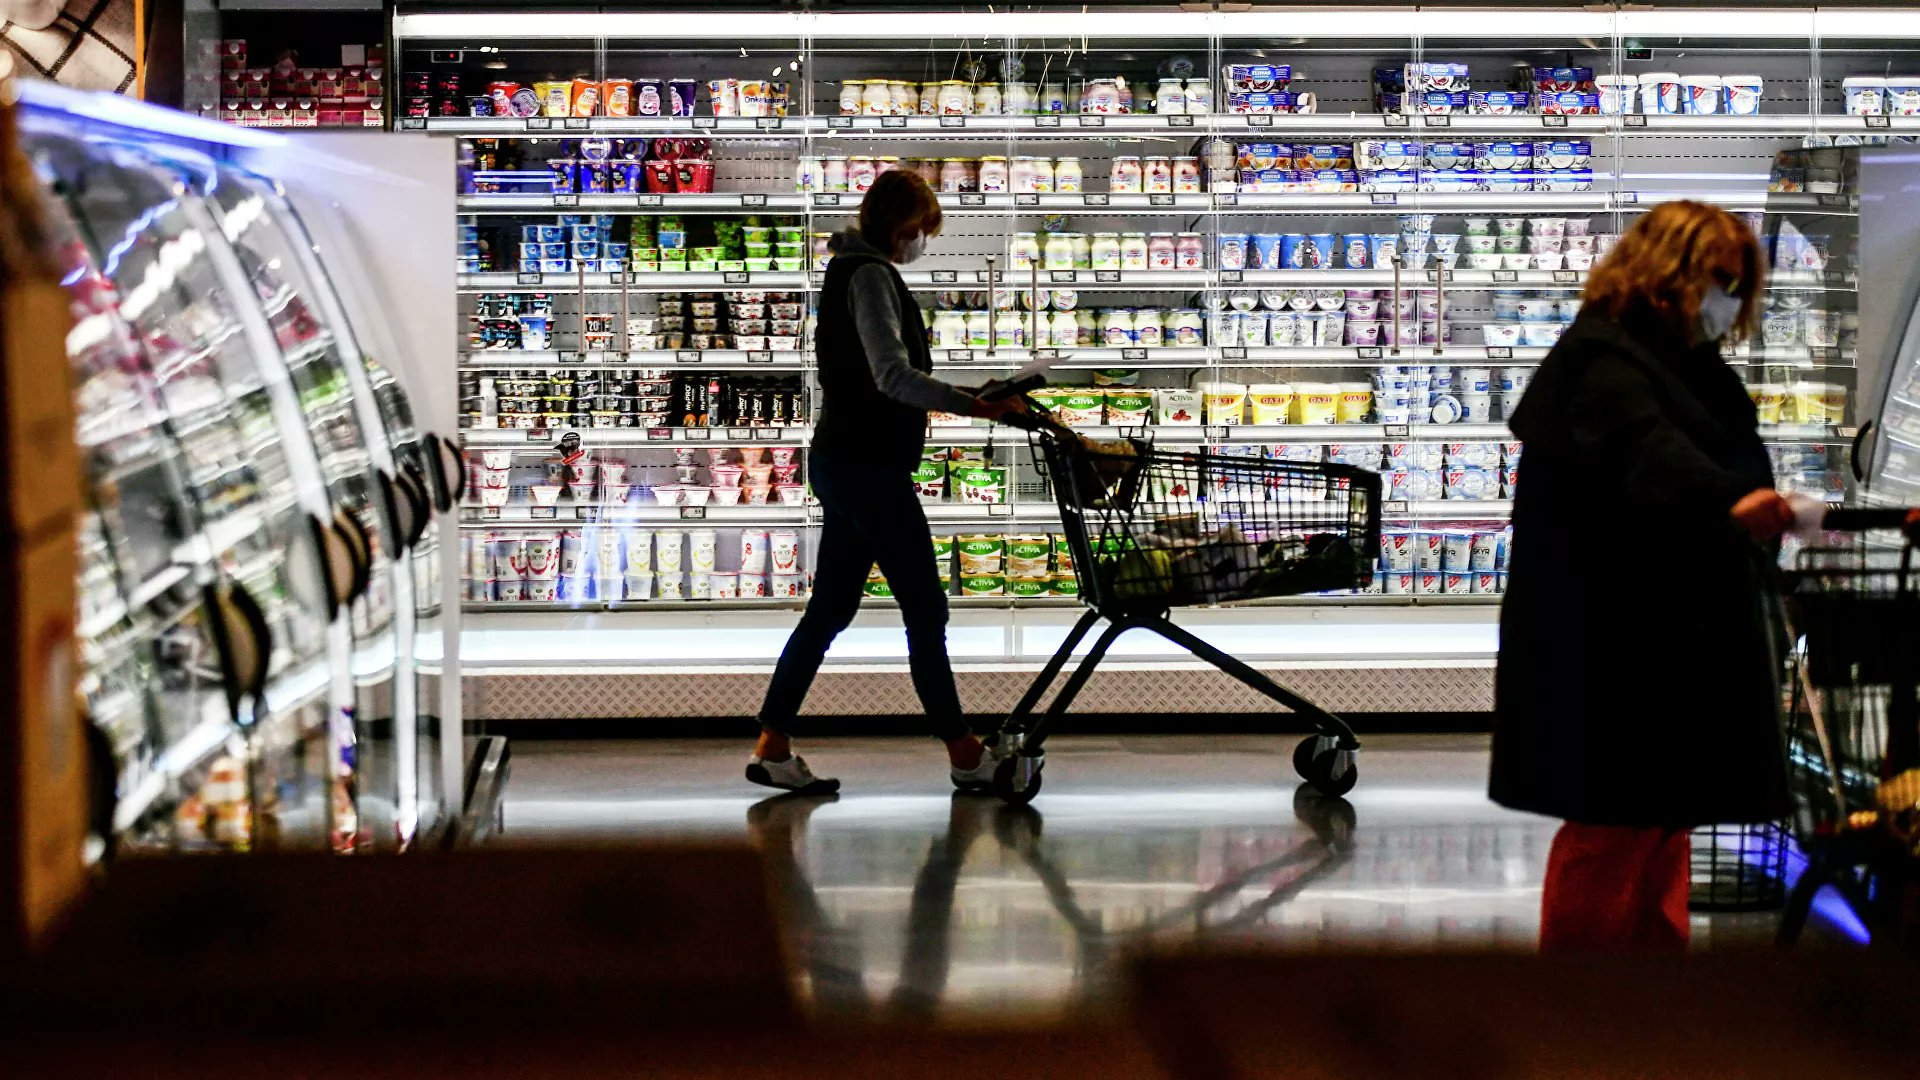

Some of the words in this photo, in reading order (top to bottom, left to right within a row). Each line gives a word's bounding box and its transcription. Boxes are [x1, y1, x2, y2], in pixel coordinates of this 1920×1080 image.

[588, 320, 599, 331] 20
[966, 474, 992, 482] ACTIVIA
[1014, 546, 1041, 554] ACTIVIA
[969, 579, 996, 587] ACTIVIA
